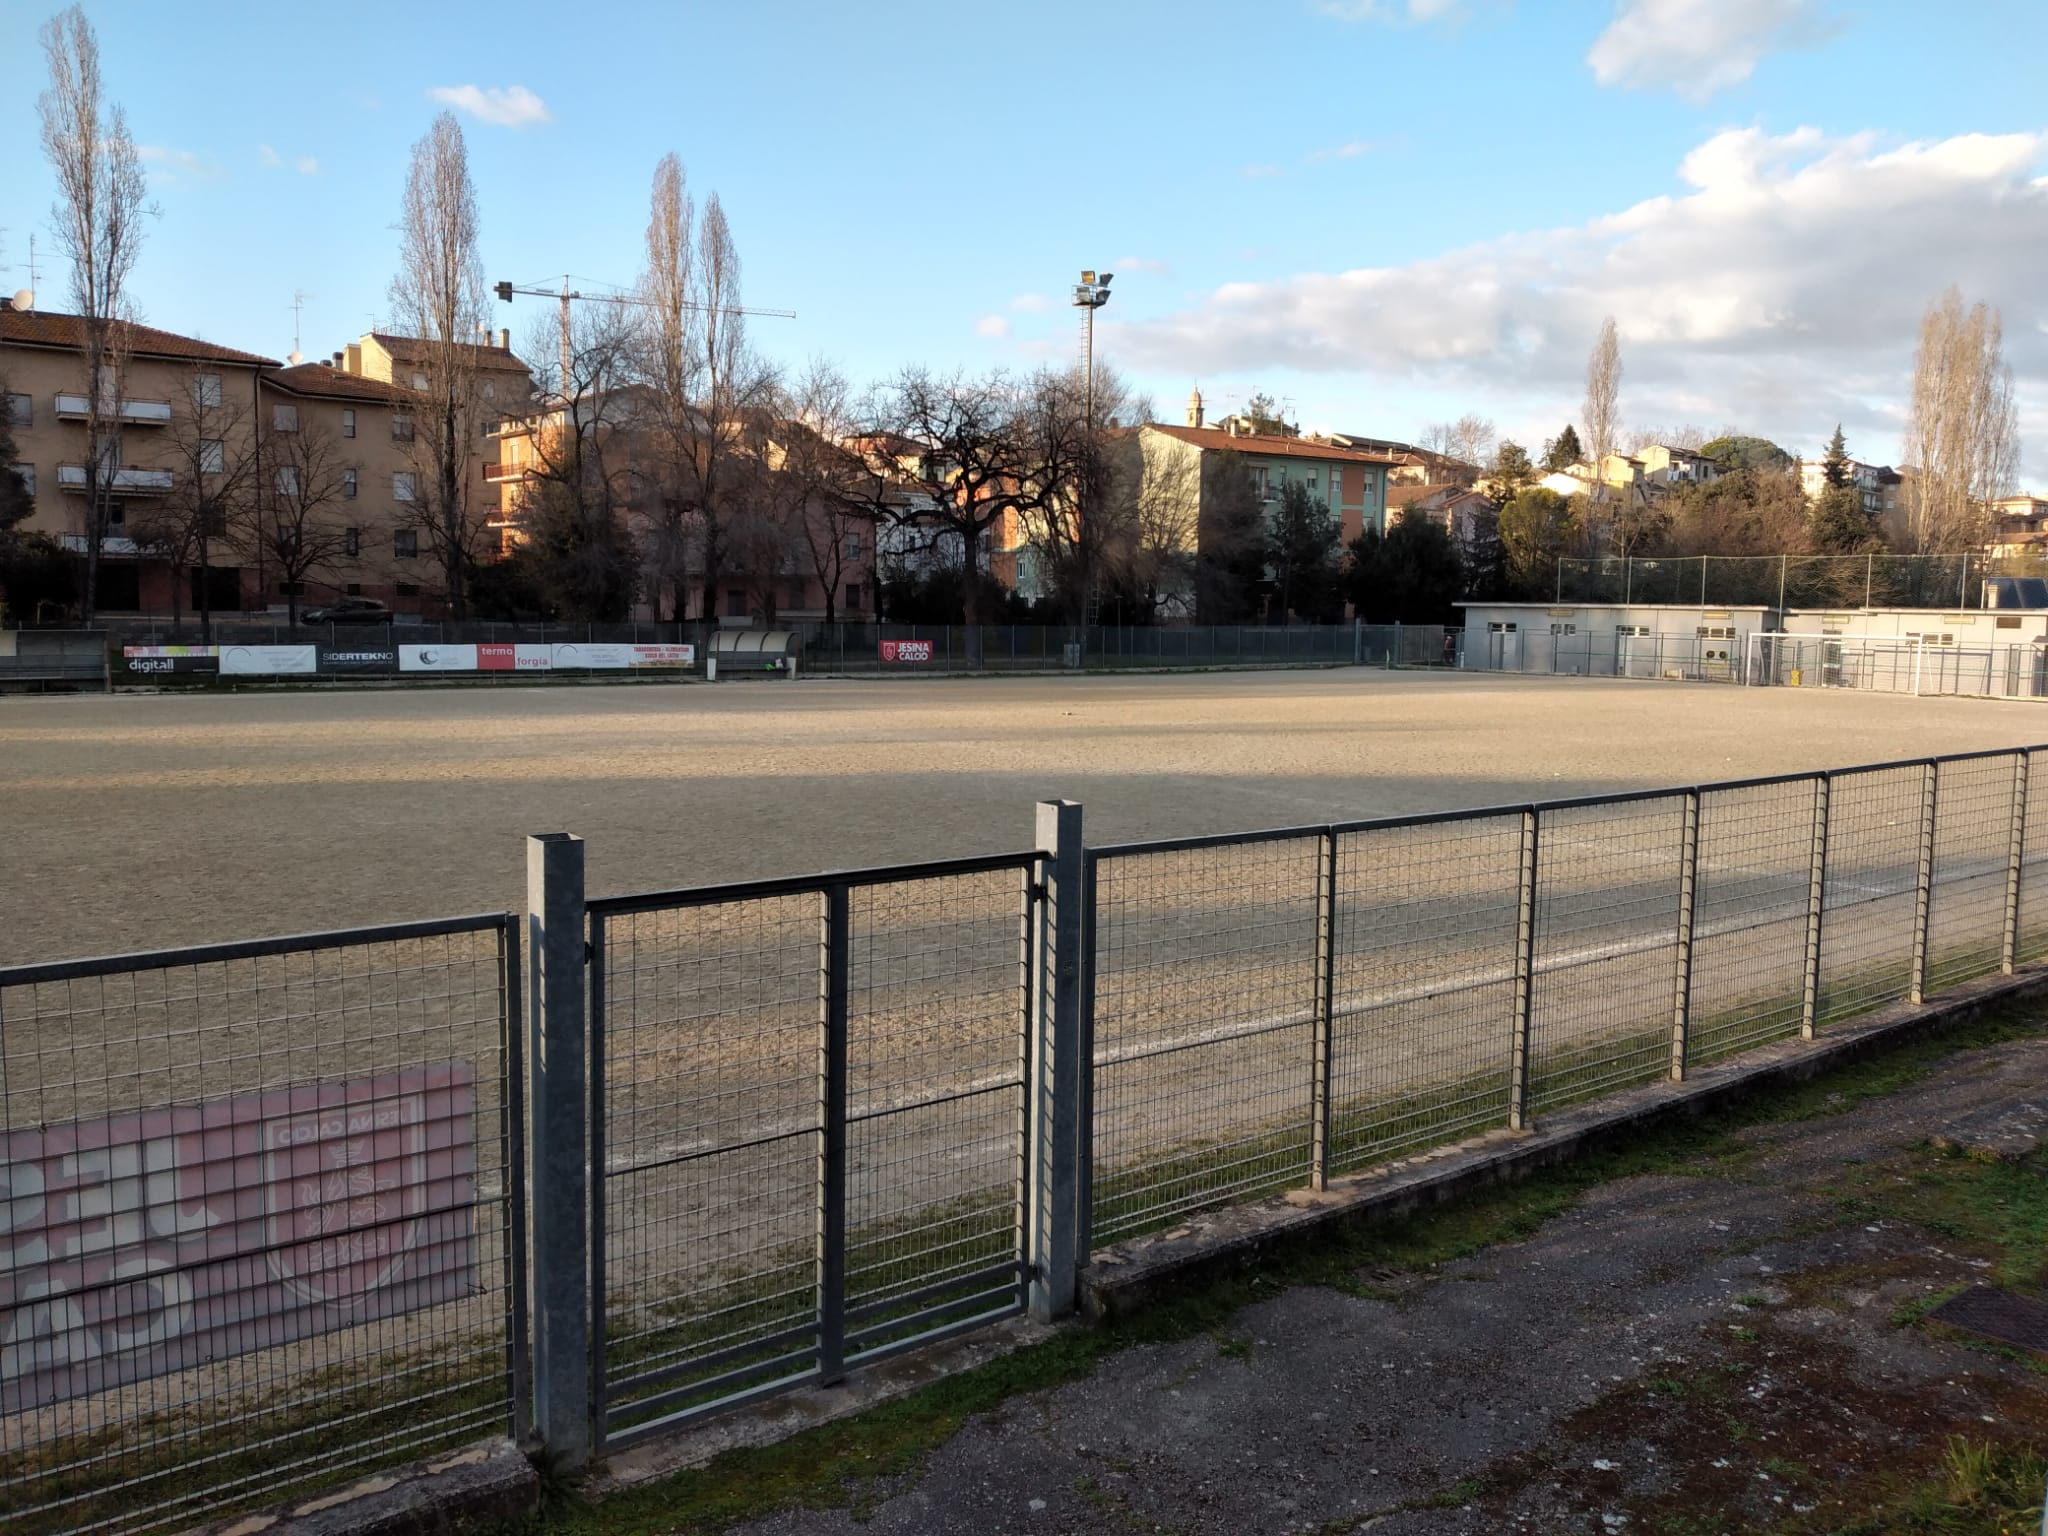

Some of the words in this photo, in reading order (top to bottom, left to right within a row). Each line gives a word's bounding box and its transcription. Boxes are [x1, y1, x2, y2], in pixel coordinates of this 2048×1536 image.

[481, 647, 513, 656] termo
[897, 643, 930, 652] JESINA
[322, 652, 394, 661] SIDERTEKNO
[899, 652, 929, 661] CALCIO
[128, 658, 175, 673] digitall
[516, 657, 548, 667] forgia
